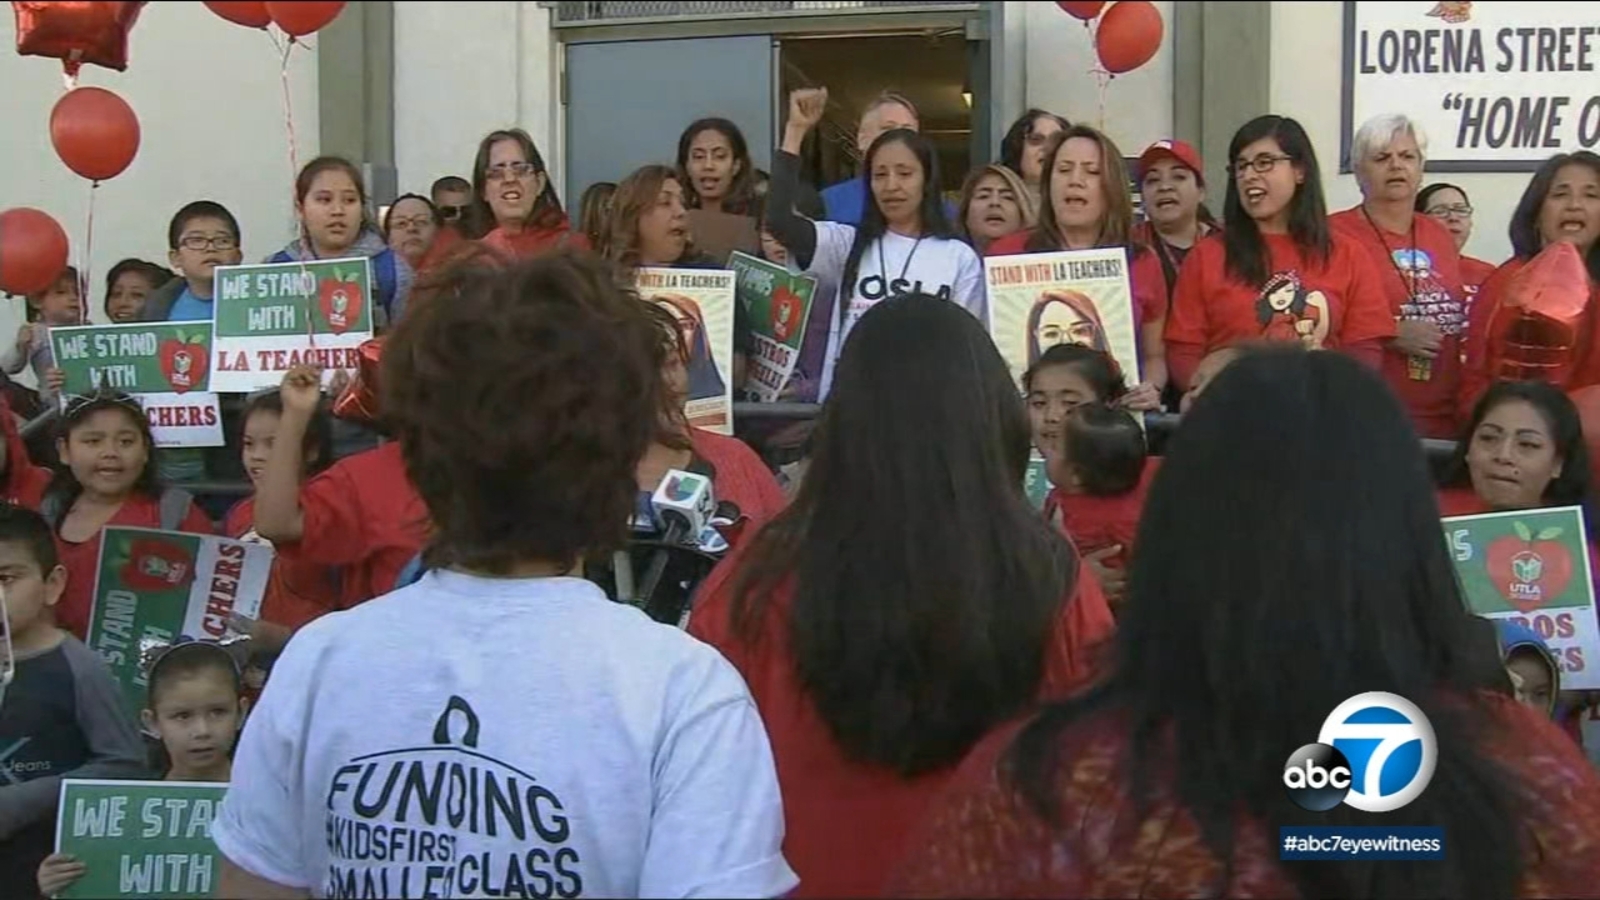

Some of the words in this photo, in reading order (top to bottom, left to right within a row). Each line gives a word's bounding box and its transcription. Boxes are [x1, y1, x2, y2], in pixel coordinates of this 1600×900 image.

[1360, 28, 1485, 74] LORENA
[1495, 27, 1600, 73] STREE
[222, 273, 250, 300] WE
[256, 271, 316, 298] STAND
[665, 274, 677, 288] LA
[989, 265, 1022, 286] STAND
[1024, 262, 1052, 283] WITH
[1053, 261, 1067, 281] LA
[1068, 258, 1122, 280] TEACHERS!
[248, 305, 295, 331] WITH
[59, 334, 90, 360] WE
[94, 332, 158, 358] STAND
[216, 350, 250, 372] LA
[1509, 582, 1542, 594] UTLA
[327, 760, 570, 844] FUNDING
[73, 796, 128, 838] WE
[142, 797, 224, 838] STA
[119, 853, 213, 894] WITH
[458, 847, 582, 899] CLASS
